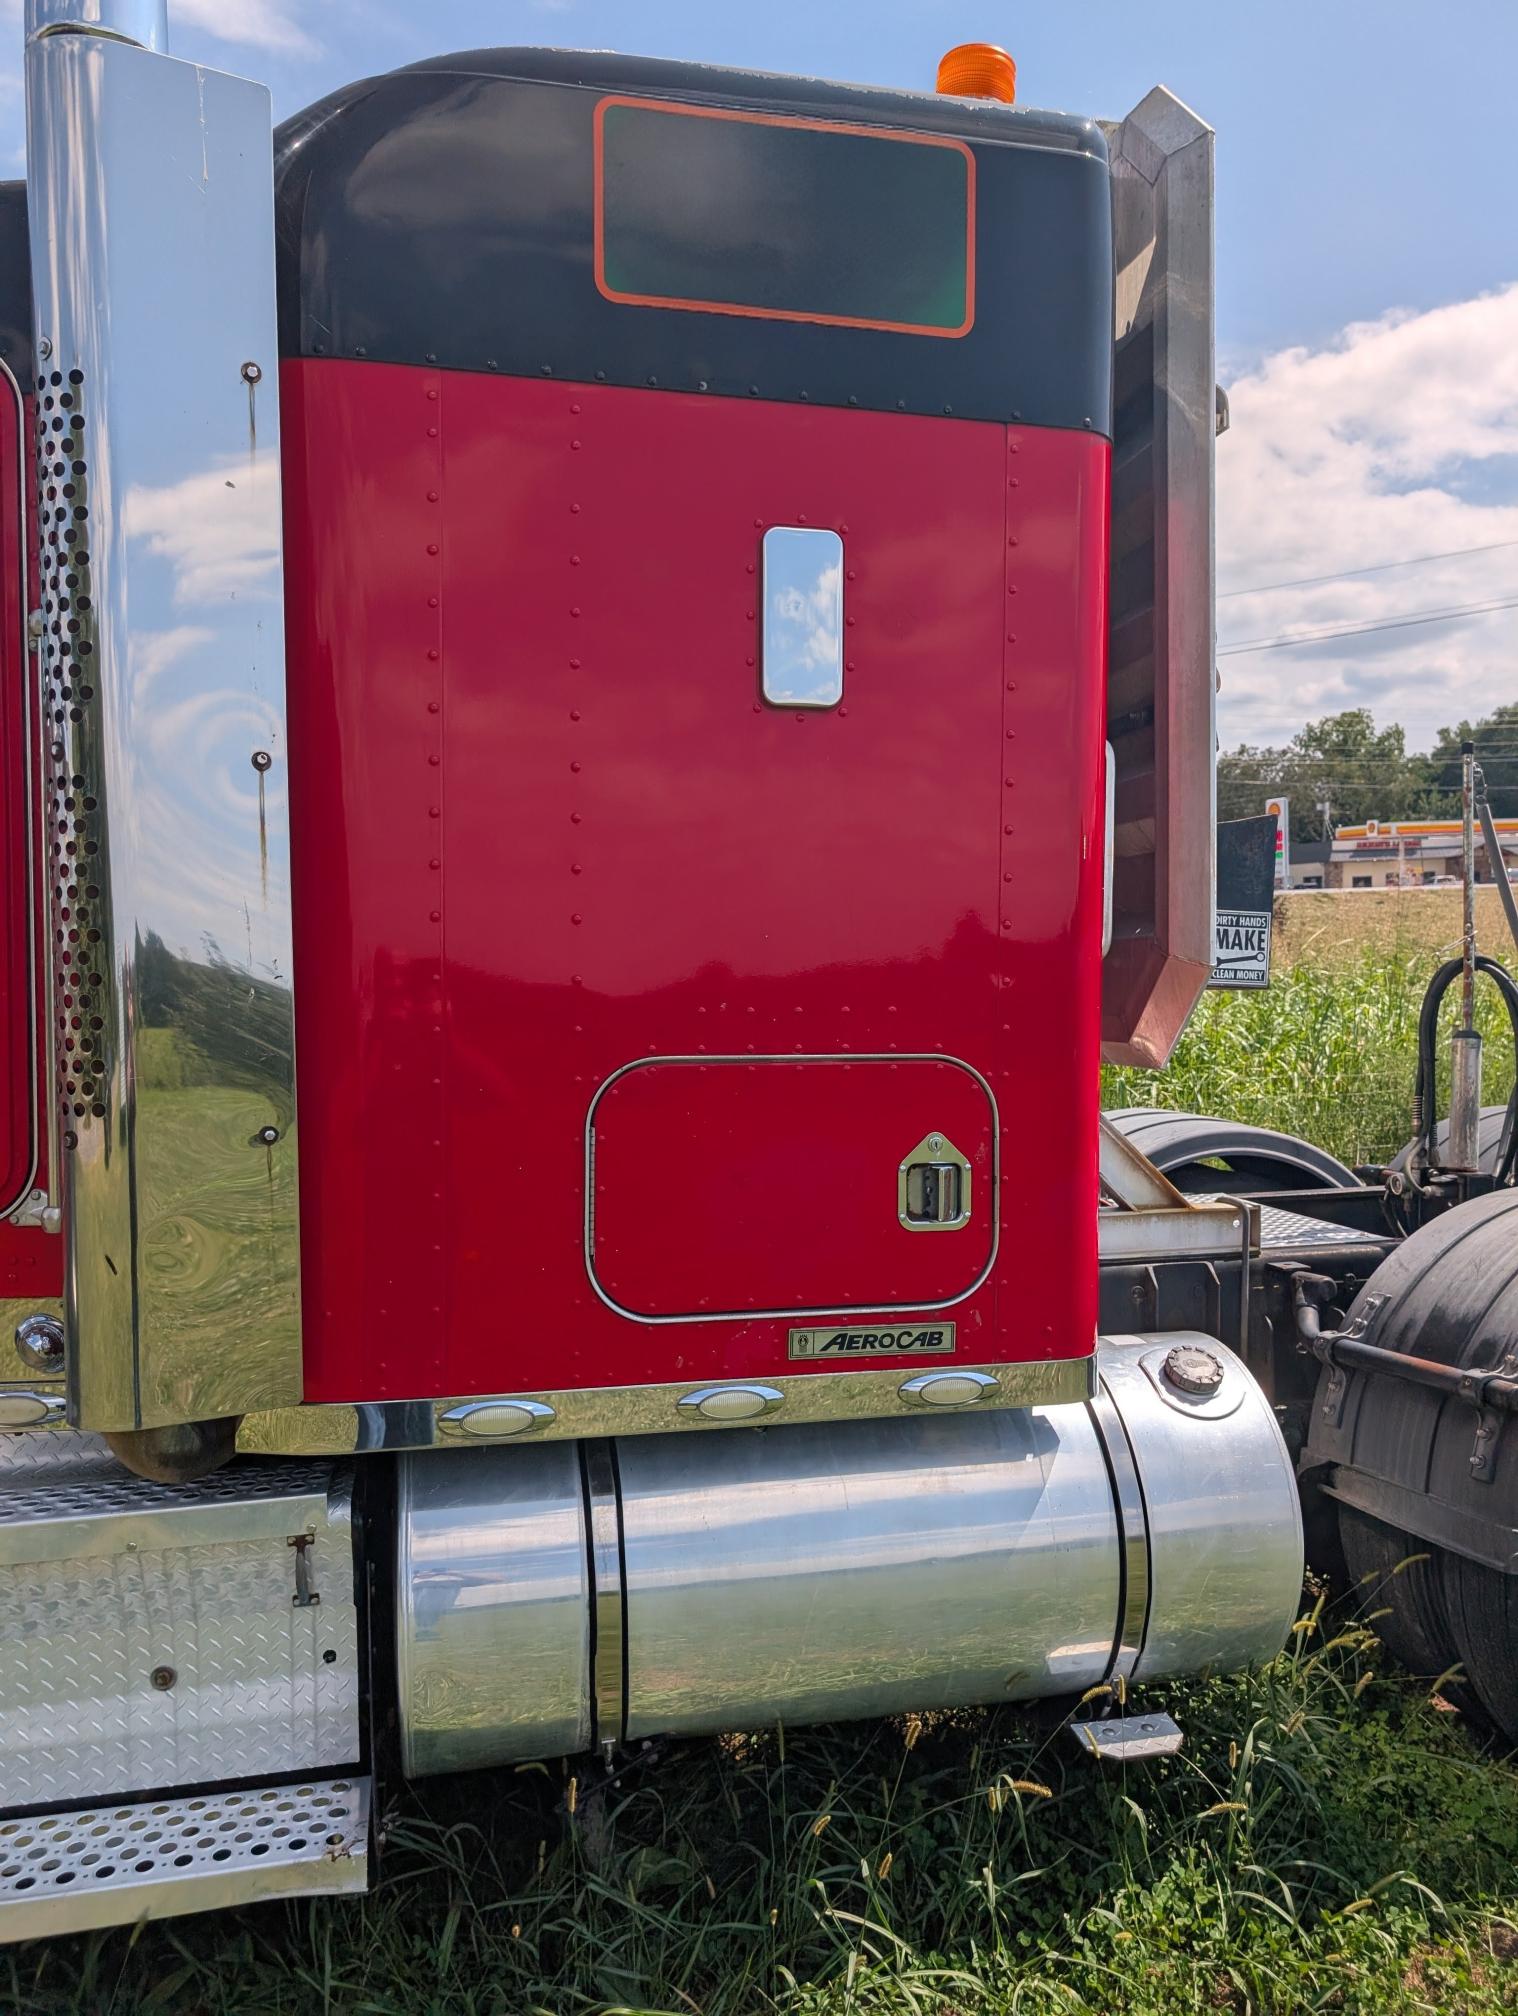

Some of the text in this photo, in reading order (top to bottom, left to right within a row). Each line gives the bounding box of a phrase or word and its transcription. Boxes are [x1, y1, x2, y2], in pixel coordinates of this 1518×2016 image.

[1216, 915, 1266, 927] DIRTY HANDS
[1216, 928, 1266, 951] MAKE
[1212, 969, 1263, 980] CLEAN MONEY
[819, 1331, 944, 1352] AEROCAB
